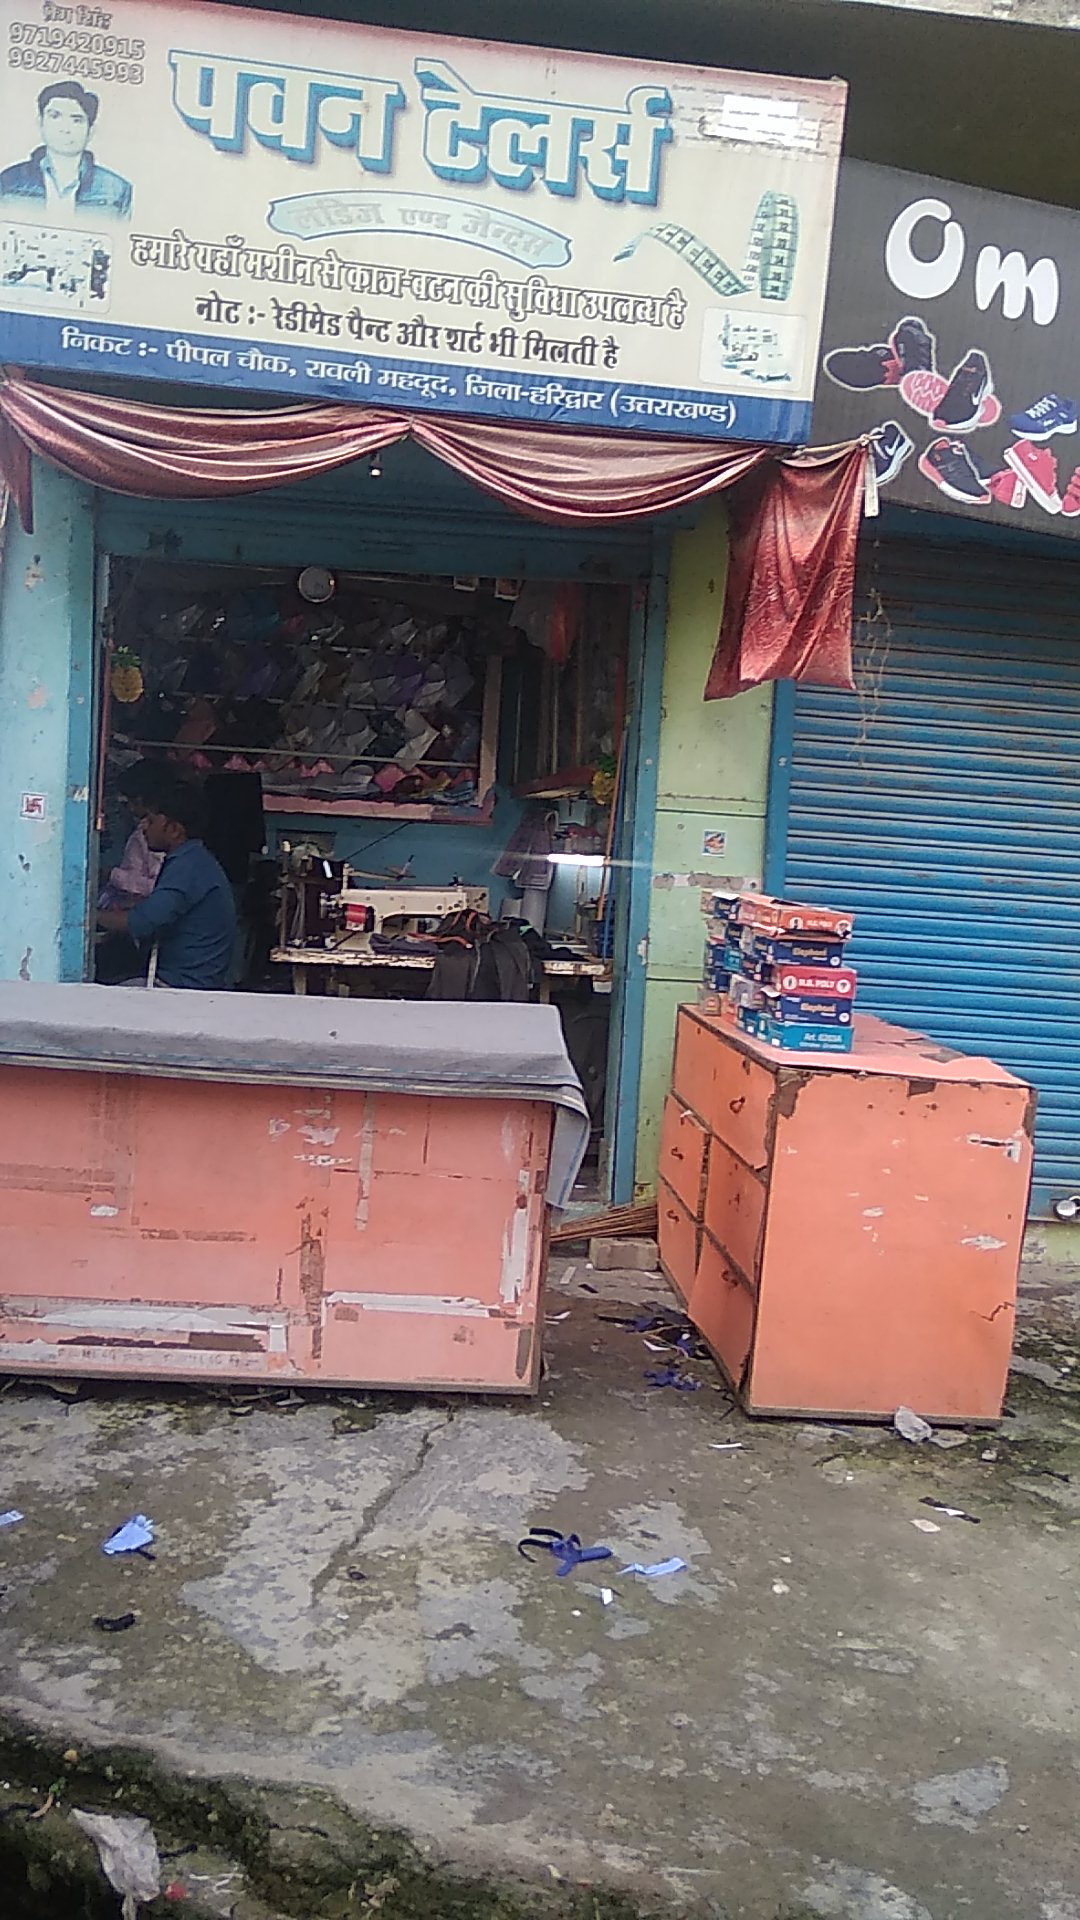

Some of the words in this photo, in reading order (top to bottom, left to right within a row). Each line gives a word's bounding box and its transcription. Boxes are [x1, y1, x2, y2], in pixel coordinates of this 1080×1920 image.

[8, 46, 144, 84] 9927445993
[9, 22, 145, 60] 9719420915
[169, 49, 406, 174] पवन
[414, 57, 673, 206] टेलर्स
[130, 229, 192, 270] हमारे
[191, 234, 243, 277] यहाँ
[243, 244, 317, 286] मशीन
[316, 248, 343, 290] से
[463, 269, 501, 309] की
[501, 275, 580, 322] सुविधा
[579, 289, 664, 327] उपलब्ध
[662, 286, 687, 329] है
[886, 198, 1059, 325] Om
[61, 327, 133, 356] निकट
[165, 339, 230, 368] पीपल
[237, 347, 296, 378] चौक,
[305, 357, 373, 385] रावली
[378, 369, 457, 399] महदूद,
[610, 388, 736, 428] (उत्तराखण्ड)
[196, 291, 243, 324] नोट
[270, 297, 343, 337] रेडीमेड
[346, 307, 393, 342] पैन्ट
[397, 315, 441, 349] और
[445, 321, 485, 353] शर्ट
[490, 327, 519, 358] भी
[521, 328, 597, 367] मिलती
[602, 336, 620, 368] है
